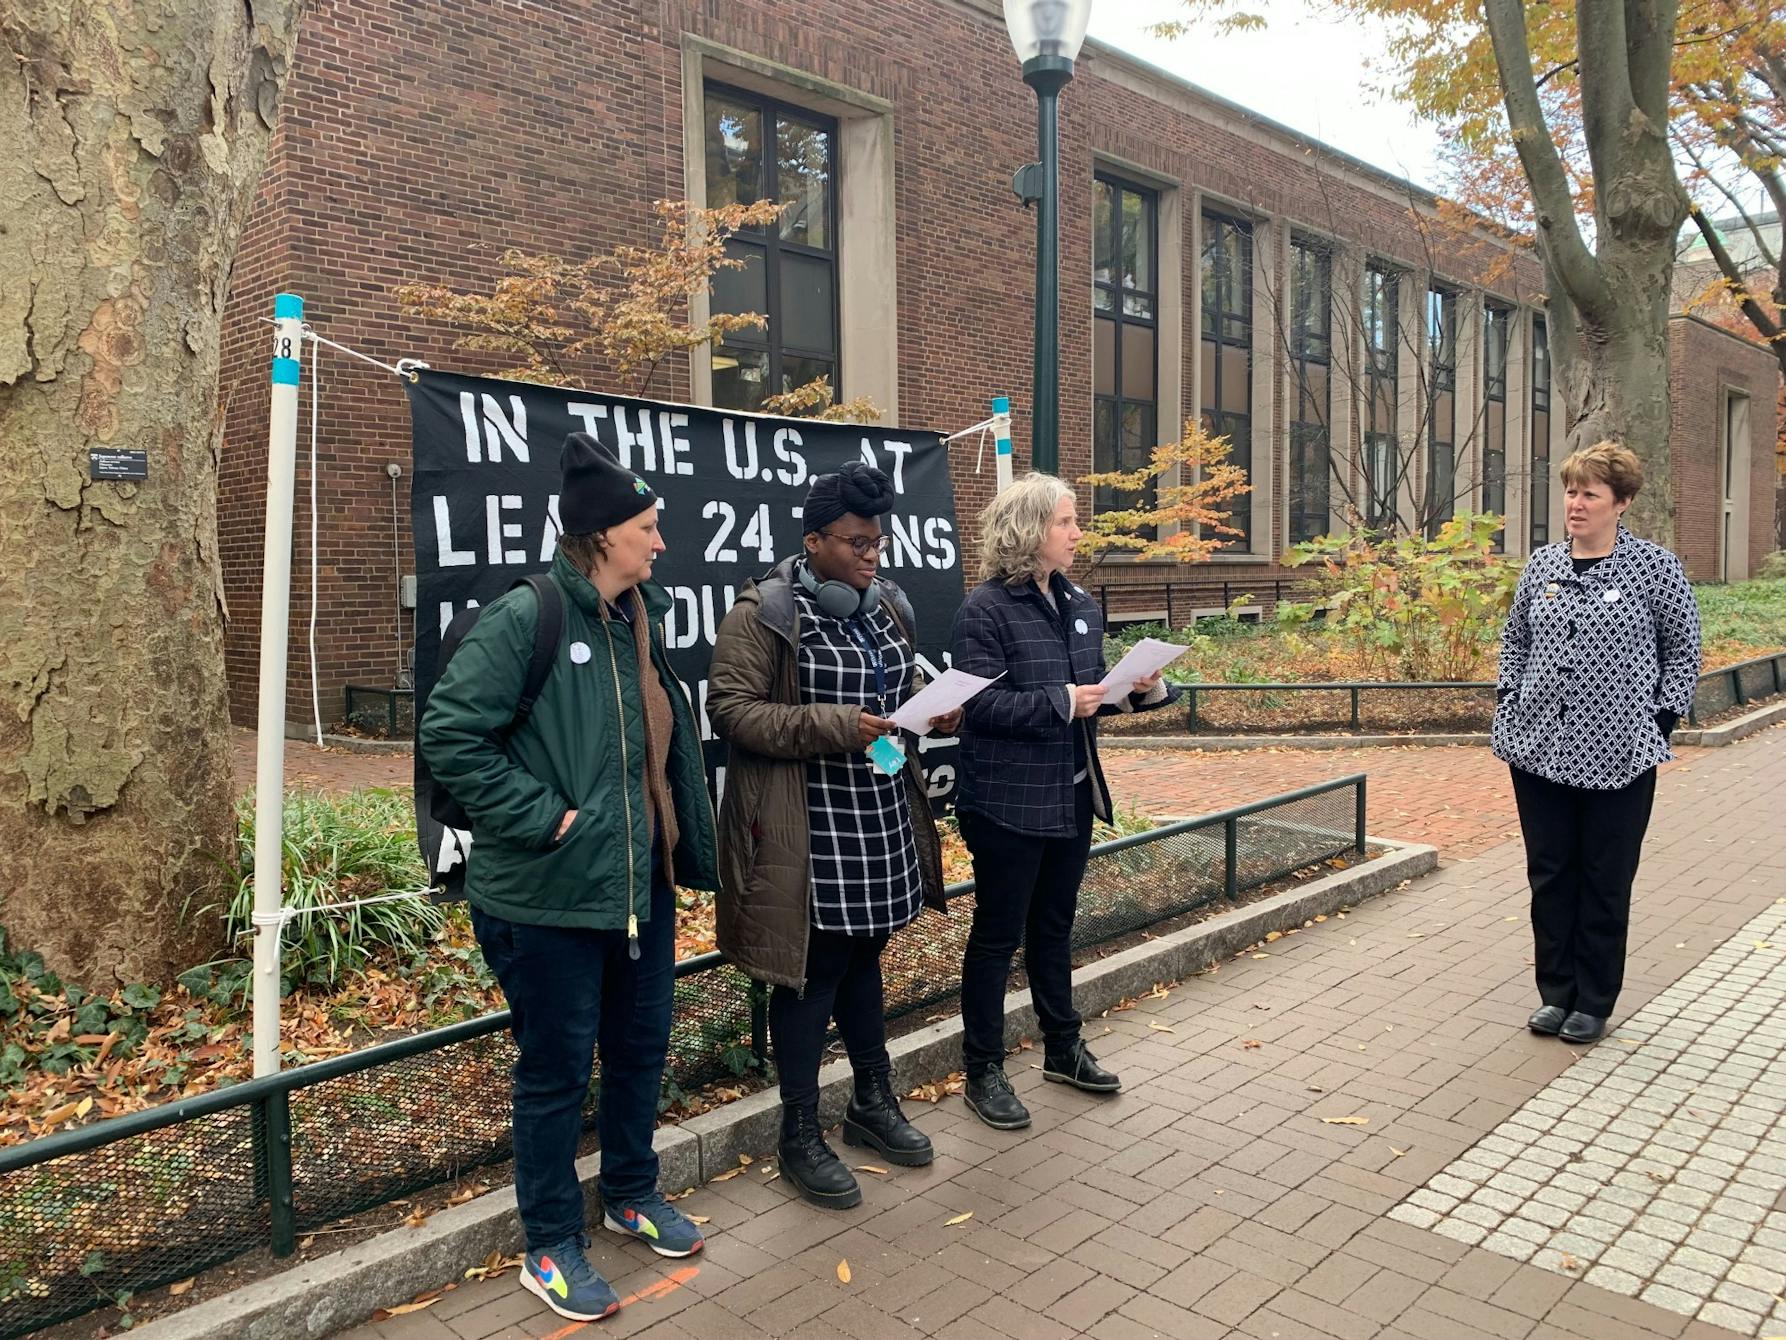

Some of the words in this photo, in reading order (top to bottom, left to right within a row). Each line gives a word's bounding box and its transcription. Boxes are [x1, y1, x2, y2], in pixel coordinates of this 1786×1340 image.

[460, 391, 530, 463] IN
[567, 401, 694, 476] THE
[723, 418, 818, 487] U.S.
[702, 500, 774, 562] 24
